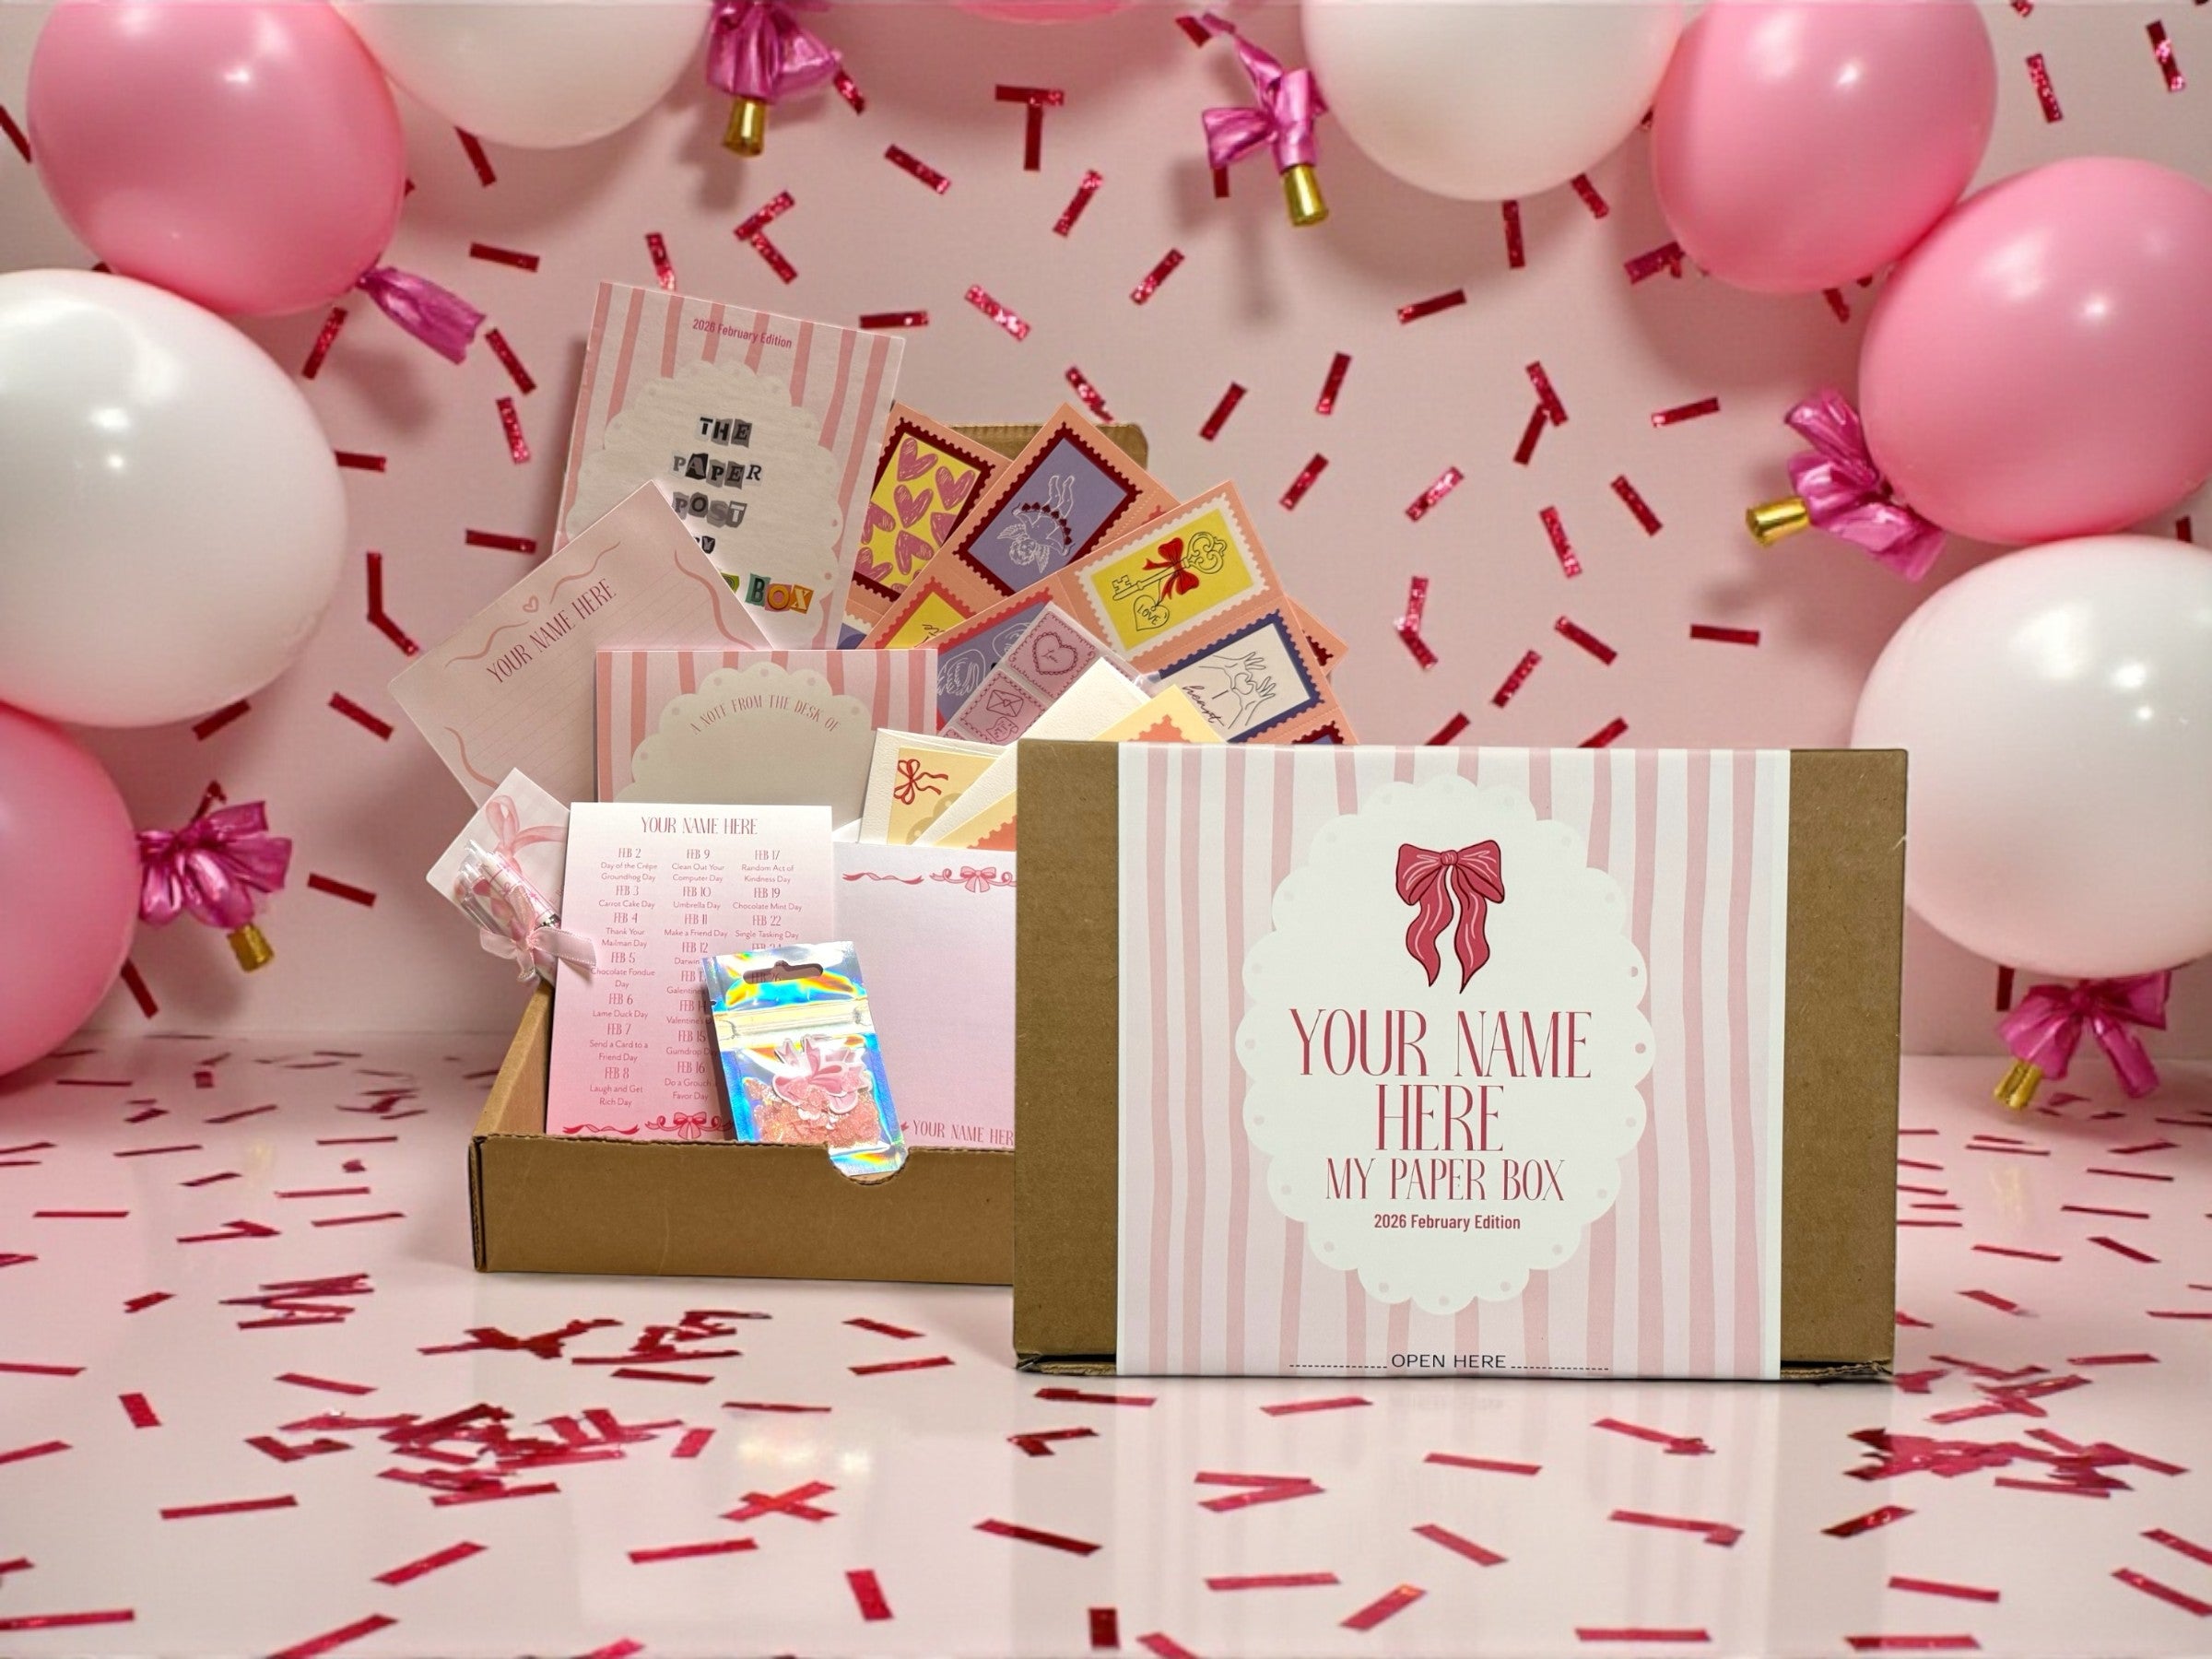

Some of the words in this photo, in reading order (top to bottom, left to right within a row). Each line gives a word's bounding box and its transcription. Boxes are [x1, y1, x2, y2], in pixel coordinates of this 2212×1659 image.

[692, 318, 716, 333] 2026
[717, 324, 759, 344] February
[760, 332, 793, 348] Edition
[699, 415, 751, 444] THE
[672, 453, 763, 486] PAPER
[673, 493, 747, 527] POST
[749, 574, 812, 613] BOX
[1136, 604, 1161, 626] LOVE
[486, 644, 533, 683] YOUR
[529, 609, 576, 653] NAME
[571, 578, 617, 619] HERE
[690, 723, 701, 735] A
[700, 704, 726, 726] NOTE
[732, 695, 763, 712] FROM
[769, 694, 791, 710] THE
[794, 700, 825, 722] DESK
[824, 717, 841, 732] OF
[641, 817, 677, 833] YOUR
[682, 818, 719, 834] NAME
[724, 818, 759, 835] HERE
[618, 848, 632, 858] FEB
[635, 848, 641, 859] 2
[686, 849, 700, 859] FEB
[704, 849, 711, 859] 9
[755, 850, 769, 860] FEB
[772, 850, 781, 860] 17
[600, 862, 614, 871] Day
[615, 861, 624, 869] of
[671, 863, 692, 871] Clean
[693, 863, 708, 871] Out
[741, 864, 771, 872] Random
[772, 864, 784, 872] Act
[786, 864, 794, 872] of
[601, 873, 641, 883] Groundhog
[641, 873, 656, 882] Day
[672, 873, 708, 883] Computer
[709, 874, 724, 883] Day
[744, 875, 776, 883] Kindness
[777, 875, 792, 884] Day
[616, 886, 630, 896] FEB
[632, 886, 639, 896] 3
[683, 886, 697, 897] FEB
[700, 887, 712, 898] 10
[754, 888, 768, 898] FEB
[771, 888, 781, 899] 19
[598, 900, 621, 908] Carrot
[622, 900, 641, 908] Cake
[641, 900, 655, 910] Day
[673, 900, 706, 909] Umbrella
[706, 901, 722, 911] Day
[732, 902, 769, 911] Chocolate
[770, 902, 787, 911] Mint
[788, 903, 803, 912] Day
[614, 912, 629, 924] FEB
[631, 912, 638, 924] 4
[684, 913, 699, 924] FEB
[701, 913, 708, 924] 11
[752, 915, 767, 926] FEB
[771, 915, 782, 927] 22
[606, 927, 628, 935] Thank
[629, 927, 645, 935] Your
[689, 929, 712, 937] Friend
[713, 930, 728, 939] Day
[735, 929, 756, 940] Single
[758, 930, 783, 940] Tasking
[784, 931, 799, 940] Day
[601, 939, 632, 947] Mailman
[633, 939, 647, 948] Day
[682, 942, 697, 953] FEB
[700, 942, 708, 954] 12
[611, 951, 626, 963] FEB
[629, 951, 636, 963] 5
[674, 957, 700, 965] Darwin
[591, 968, 627, 976] Chocolate
[629, 968, 655, 976] Fondue
[681, 971, 696, 982] FEB
[615, 979, 629, 988] Day
[608, 994, 624, 1005] FEB
[627, 994, 633, 1005] 6
[679, 1000, 694, 1012] FEB
[593, 1009, 612, 1018] Lame
[614, 1010, 633, 1018] Duck
[634, 1010, 649, 1019] Day
[607, 1023, 622, 1035] FEB
[626, 1023, 632, 1035] 7
[678, 1030, 693, 1042] FEB
[697, 1030, 707, 1042] 15
[589, 1040, 608, 1048] Send
[615, 1040, 633, 1048] Card
[1288, 1008, 1430, 1077] YOUR
[1453, 1010, 1593, 1078] NAME
[665, 1046, 701, 1057] Gumdrop
[598, 1053, 621, 1061] Friend
[623, 1053, 639, 1063] Day
[605, 1066, 619, 1079] FEB
[622, 1067, 629, 1079] 8
[677, 1061, 692, 1074] FEB
[696, 1061, 706, 1074] 16
[665, 1077, 677, 1086] Do
[683, 1078, 712, 1088] Grouch
[590, 1085, 612, 1095] Laugh
[613, 1085, 628, 1093] and
[629, 1085, 643, 1093] Get
[672, 1091, 692, 1100] Favor
[693, 1091, 709, 1101] Day
[599, 1097, 617, 1106] Rich
[618, 1098, 632, 1108] Day
[1374, 1083, 1505, 1152] HERE
[912, 1119, 946, 1139] YOUR
[951, 1124, 985, 1144] NAME
[989, 1128, 1015, 1147] HER
[1325, 1157, 1377, 1200] MY
[1389, 1158, 1487, 1201] PAPER
[1501, 1159, 1565, 1202] BOX
[1373, 1213, 1407, 1229] 2026
[1410, 1214, 1471, 1232] February
[1475, 1214, 1522, 1230] Edition
[1391, 1353, 1446, 1369] OPEN
[1453, 1354, 1507, 1370] HERE
